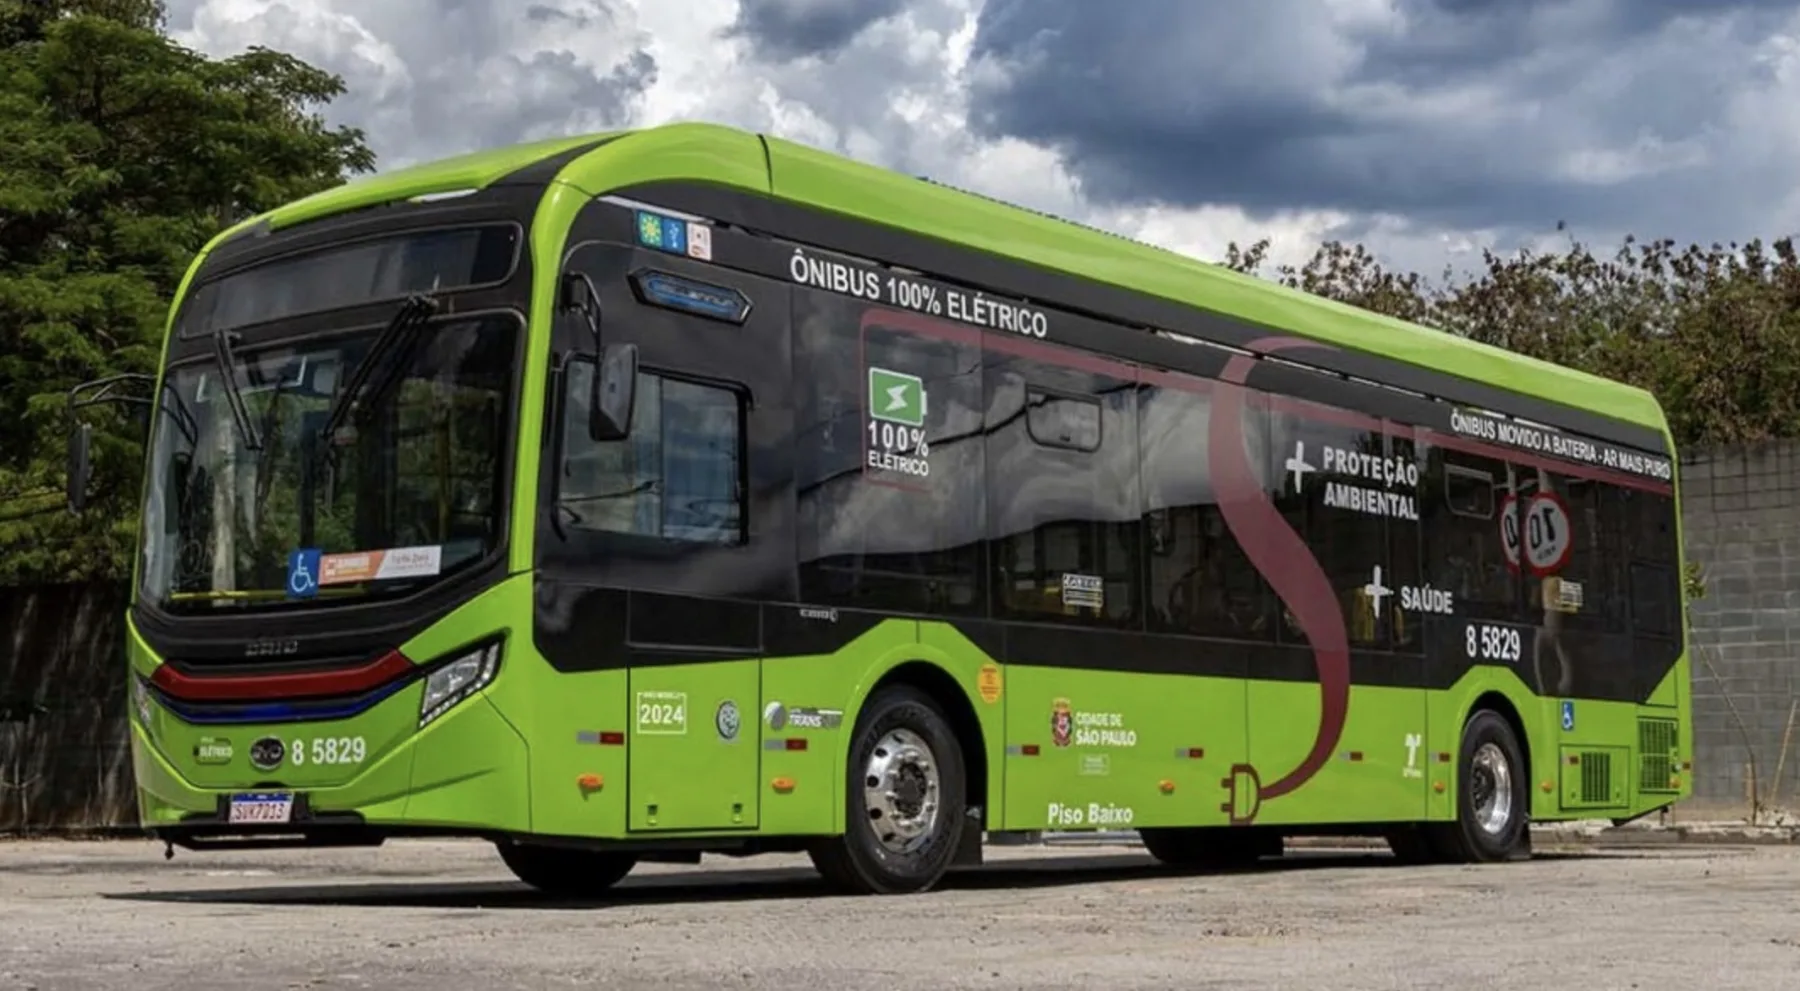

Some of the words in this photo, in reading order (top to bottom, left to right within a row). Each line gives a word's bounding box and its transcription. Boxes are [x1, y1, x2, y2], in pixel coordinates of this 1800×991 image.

[789, 248, 880, 299] ÔNIBUS
[887, 277, 941, 315] 100%
[946, 292, 1047, 338] ELÉTRICO
[868, 420, 929, 457] 100%
[1450, 408, 1495, 440] ÔNIBUS
[1498, 425, 1542, 450] MOVIDO
[1543, 435, 1551, 451] A
[1553, 438, 1597, 463] BATERIA
[1603, 450, 1618, 467] AR
[1619, 452, 1643, 474] MAIS
[1644, 459, 1671, 480] PURO
[868, 449, 929, 477] ELÉTRICO
[1323, 446, 1418, 488] PROTEÇÃO
[1323, 482, 1419, 520] AMBIENTAL
[1401, 584, 1453, 613] SAÚDE
[1466, 624, 1477, 658] 8
[1481, 626, 1521, 662] 5829
[640, 704, 684, 724] 2024
[1109, 713, 1123, 727] DE
[292, 739, 304, 766] 8
[311, 736, 366, 764] 5829
[1076, 726, 1100, 746] SÃO
[1101, 730, 1137, 746] PAULO
[1048, 802, 1083, 824] Piso
[1088, 802, 1133, 824] Baixo
